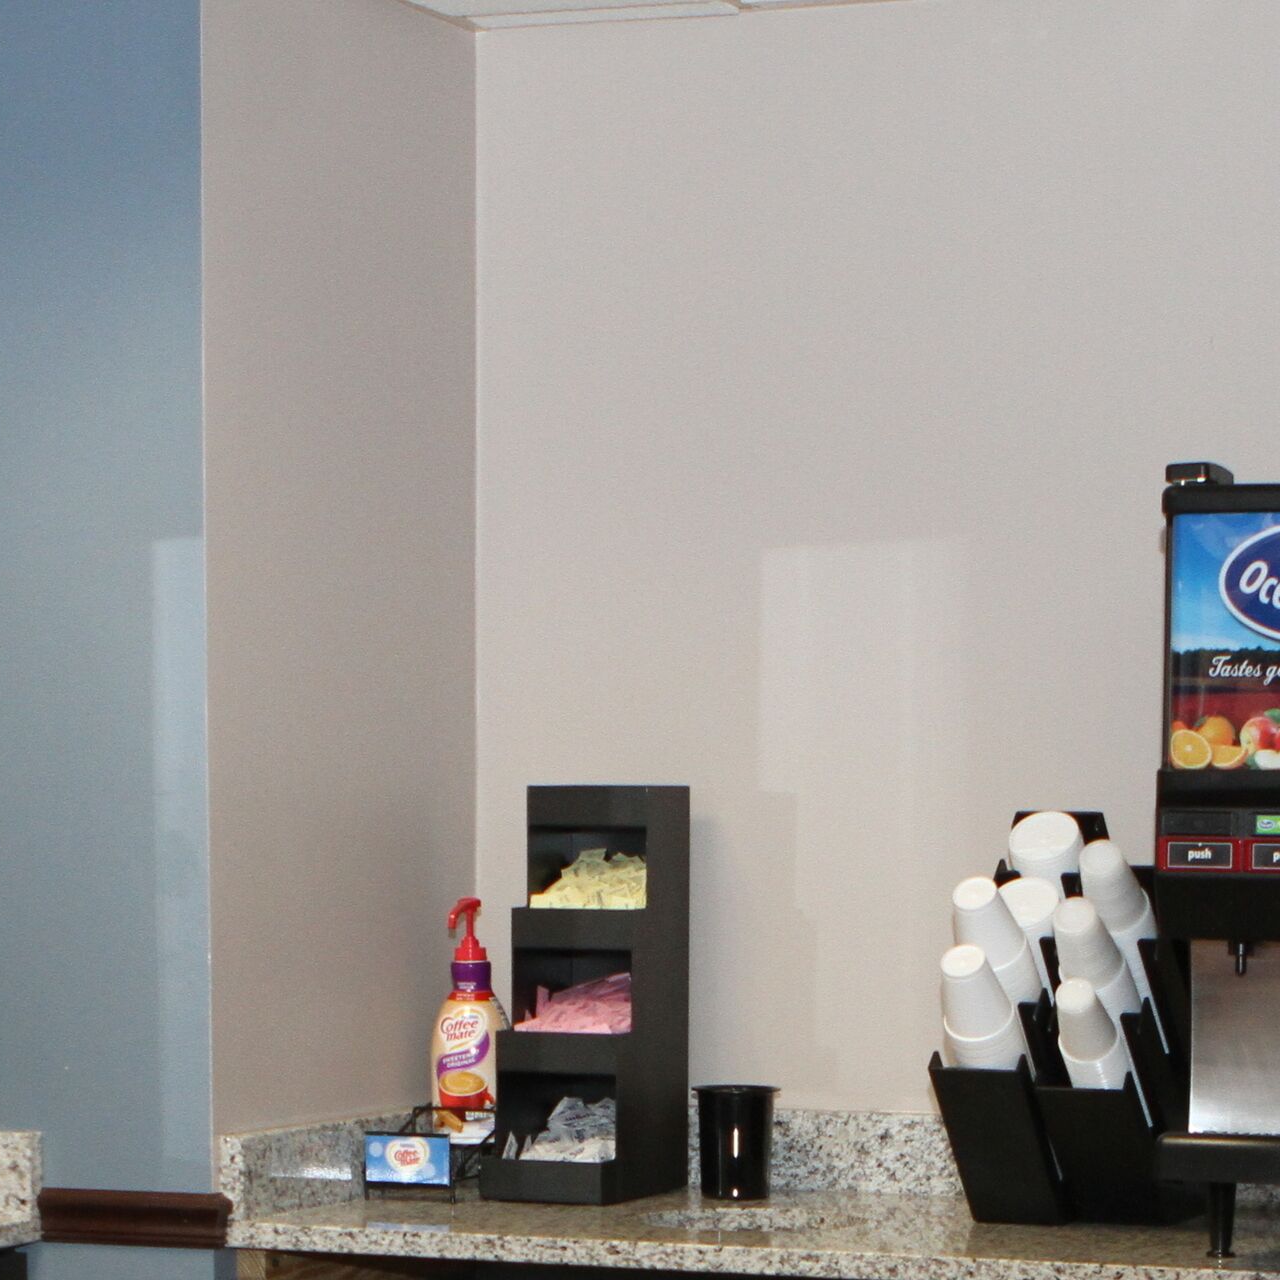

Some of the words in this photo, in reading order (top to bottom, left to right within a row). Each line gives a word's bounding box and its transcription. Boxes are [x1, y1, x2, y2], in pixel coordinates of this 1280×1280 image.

[1208, 655, 1262, 678] Tastes
[1187, 847, 1213, 862] push
[440, 1016, 479, 1034] Coffee
[446, 1029, 476, 1041] mate
